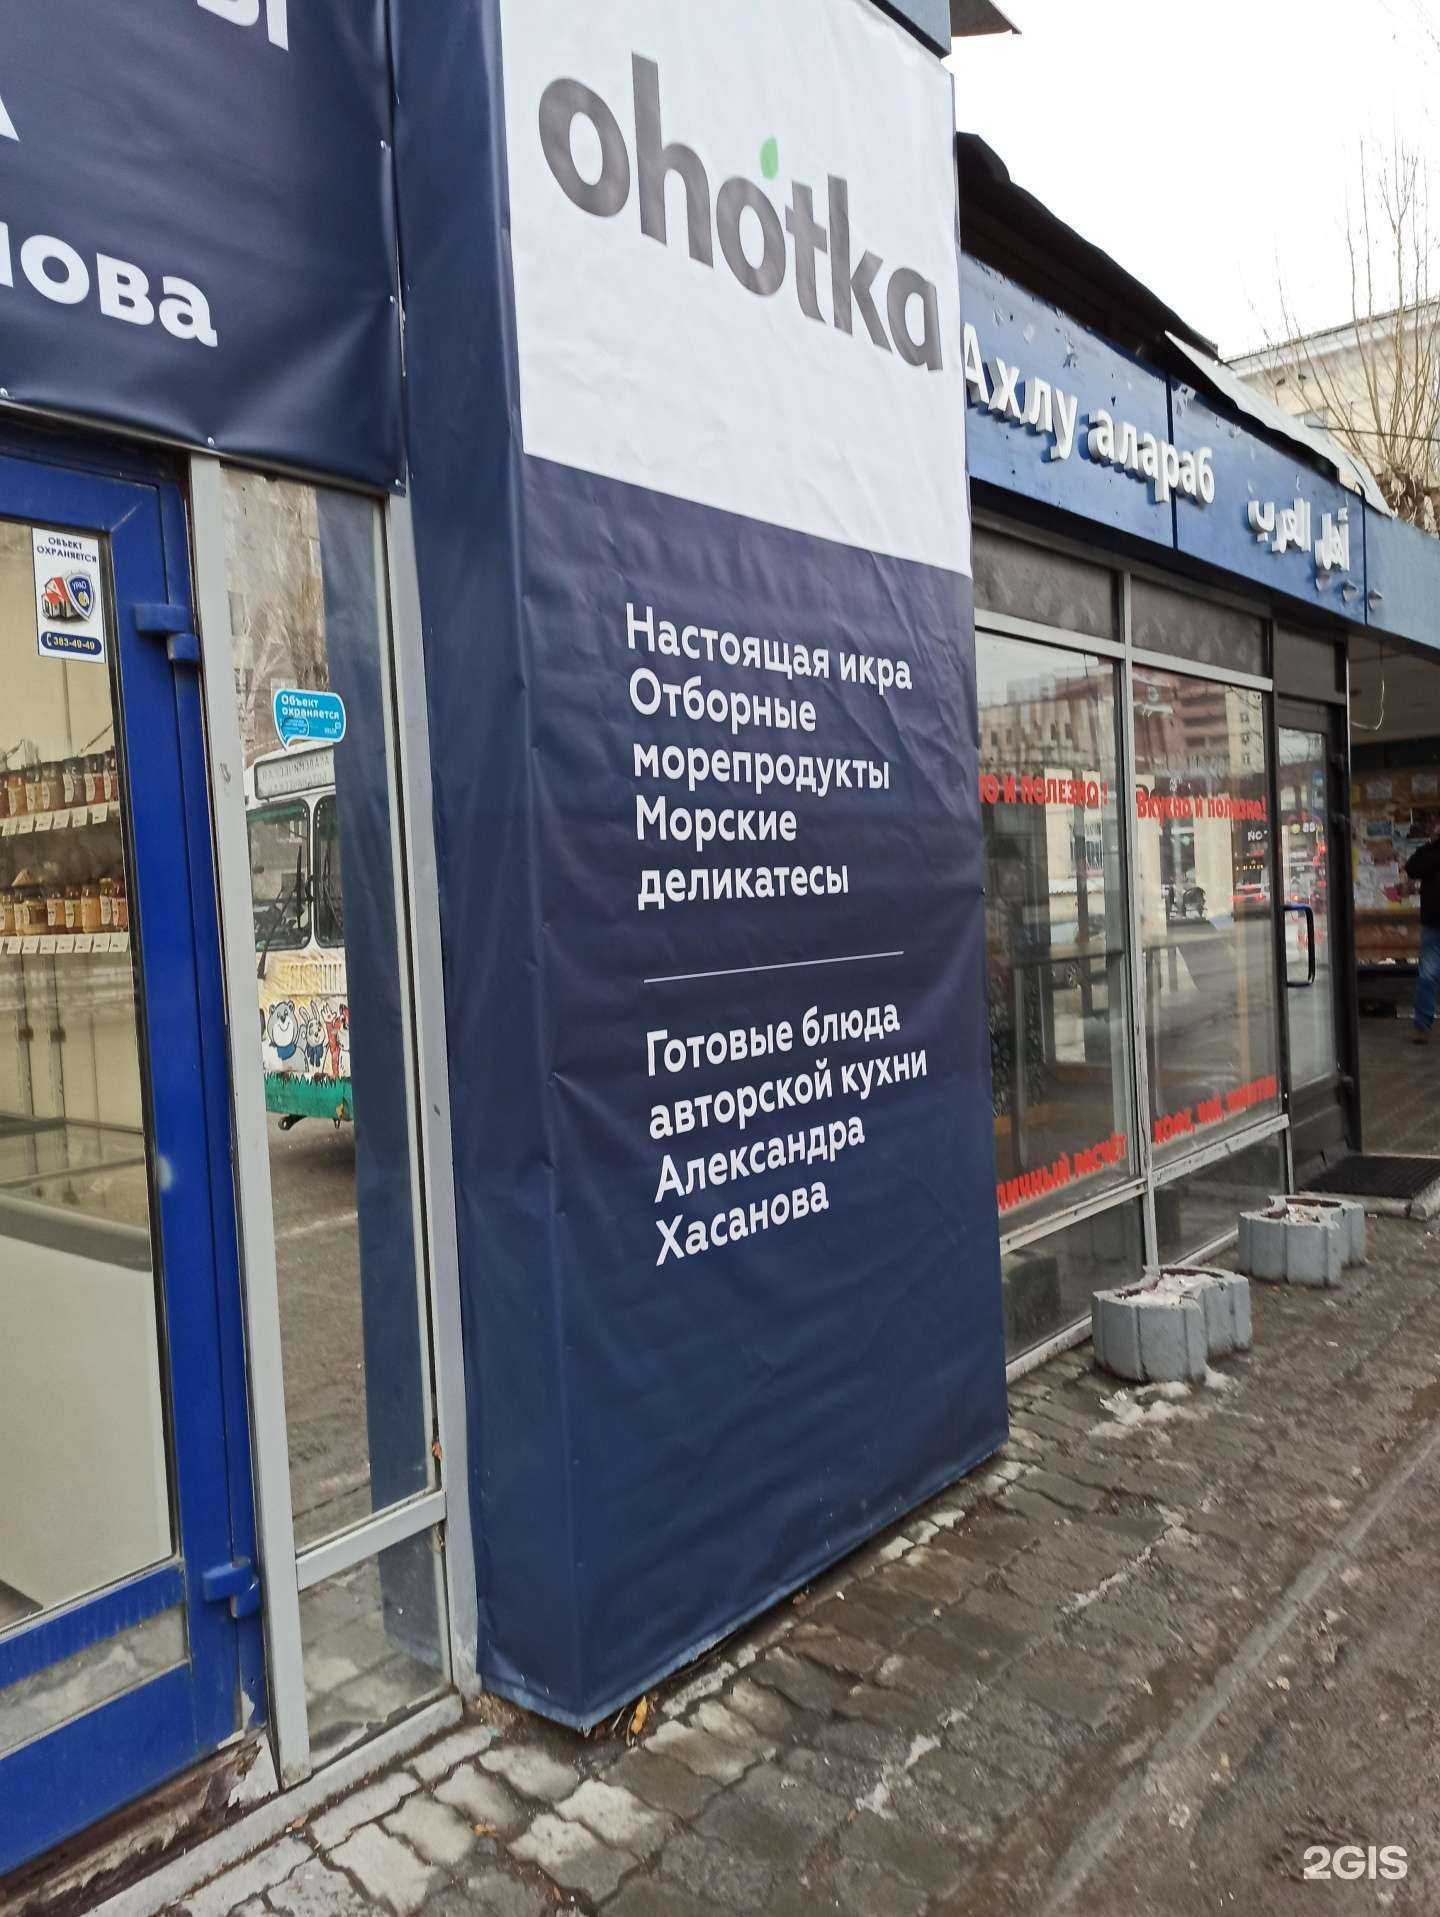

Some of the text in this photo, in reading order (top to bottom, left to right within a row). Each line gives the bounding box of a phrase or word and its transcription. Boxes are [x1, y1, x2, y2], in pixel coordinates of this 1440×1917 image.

[538, 51, 944, 371] ohotka
[963, 321, 1216, 505] Ахлу алараб
[36, 545, 98, 563] ОХРАНЯЕТСЯ
[48, 537, 83, 550] ОБЪЕКТ
[626, 602, 913, 696] Настоящая икра
[281, 693, 319, 708] Объект
[281, 706, 340, 721] охраняется
[629, 667, 817, 735] Отборные
[633, 743, 890, 797] морепродукты
[636, 795, 797, 852] Морские
[637, 865, 849, 911] деликатесы
[646, 1003, 901, 1077] Готовые блюда
[649, 1049, 928, 1140] авторской кухни
[654, 1116, 866, 1204] Александра
[655, 1181, 830, 1267] Хасанова
